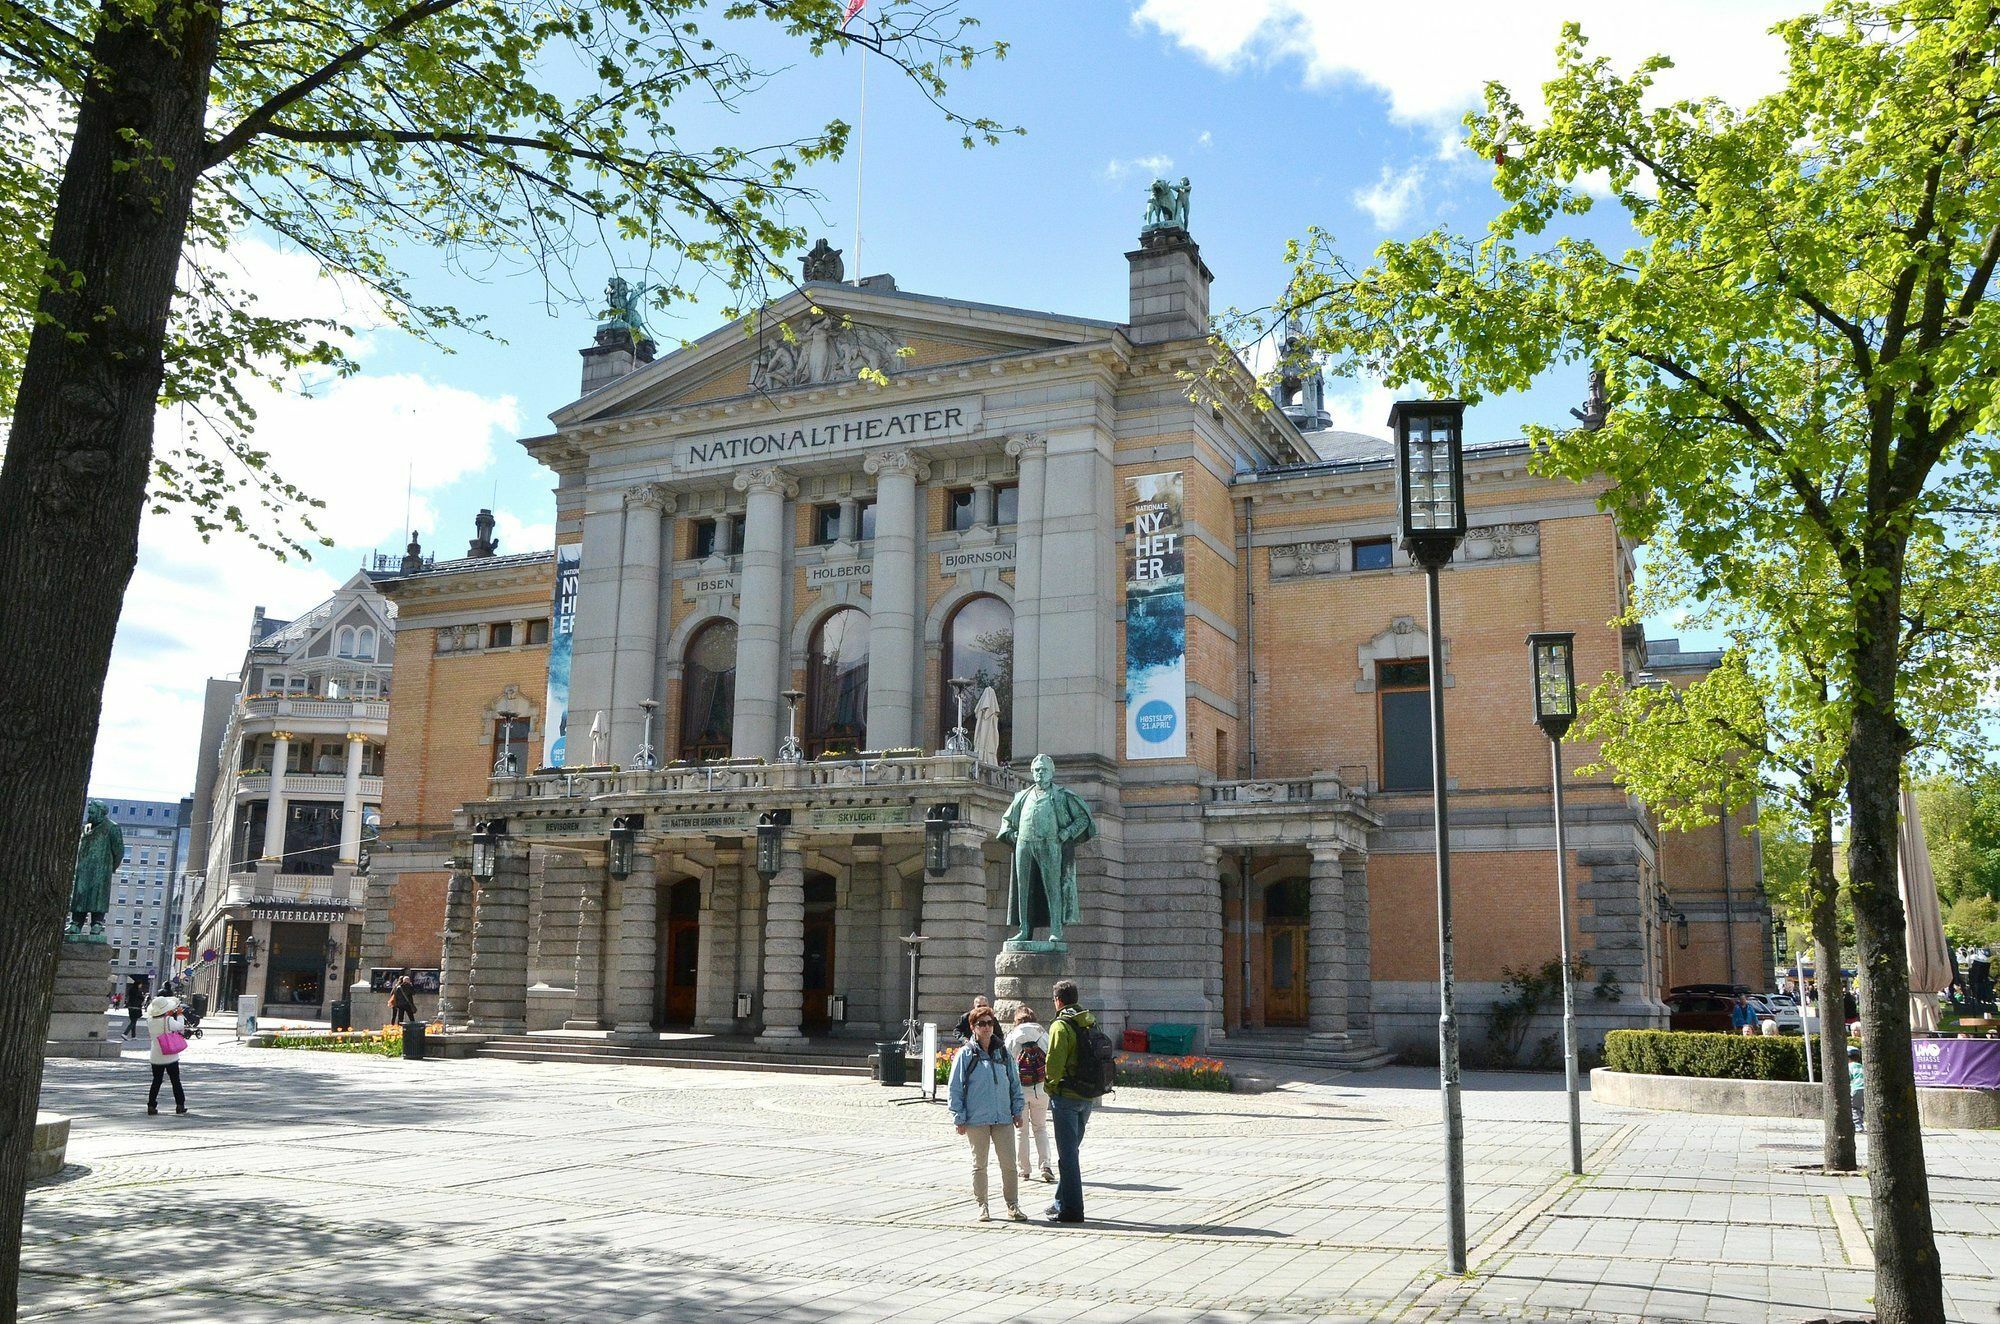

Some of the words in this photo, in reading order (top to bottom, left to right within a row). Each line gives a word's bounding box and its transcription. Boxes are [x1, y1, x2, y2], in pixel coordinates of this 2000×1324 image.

[689, 408, 964, 464] NATIONALTHEATER
[1135, 502, 1169, 512] NATIONALE
[1135, 512, 1164, 534] NY
[1135, 533, 1178, 558] HET
[945, 549, 1013, 568] BJØRNSON
[813, 564, 871, 580] HOLBERG
[1135, 557, 1164, 580] ER
[696, 578, 734, 592] IBSEN
[1151, 721, 1171, 730] APRIL
[670, 818, 692, 828] NATTEN
[837, 812, 877, 822] SKYLIGHT
[545, 822, 580, 832] REVISOREN
[248, 895, 296, 904] ANNEN
[250, 909, 345, 922] THEATERCAFEEN
